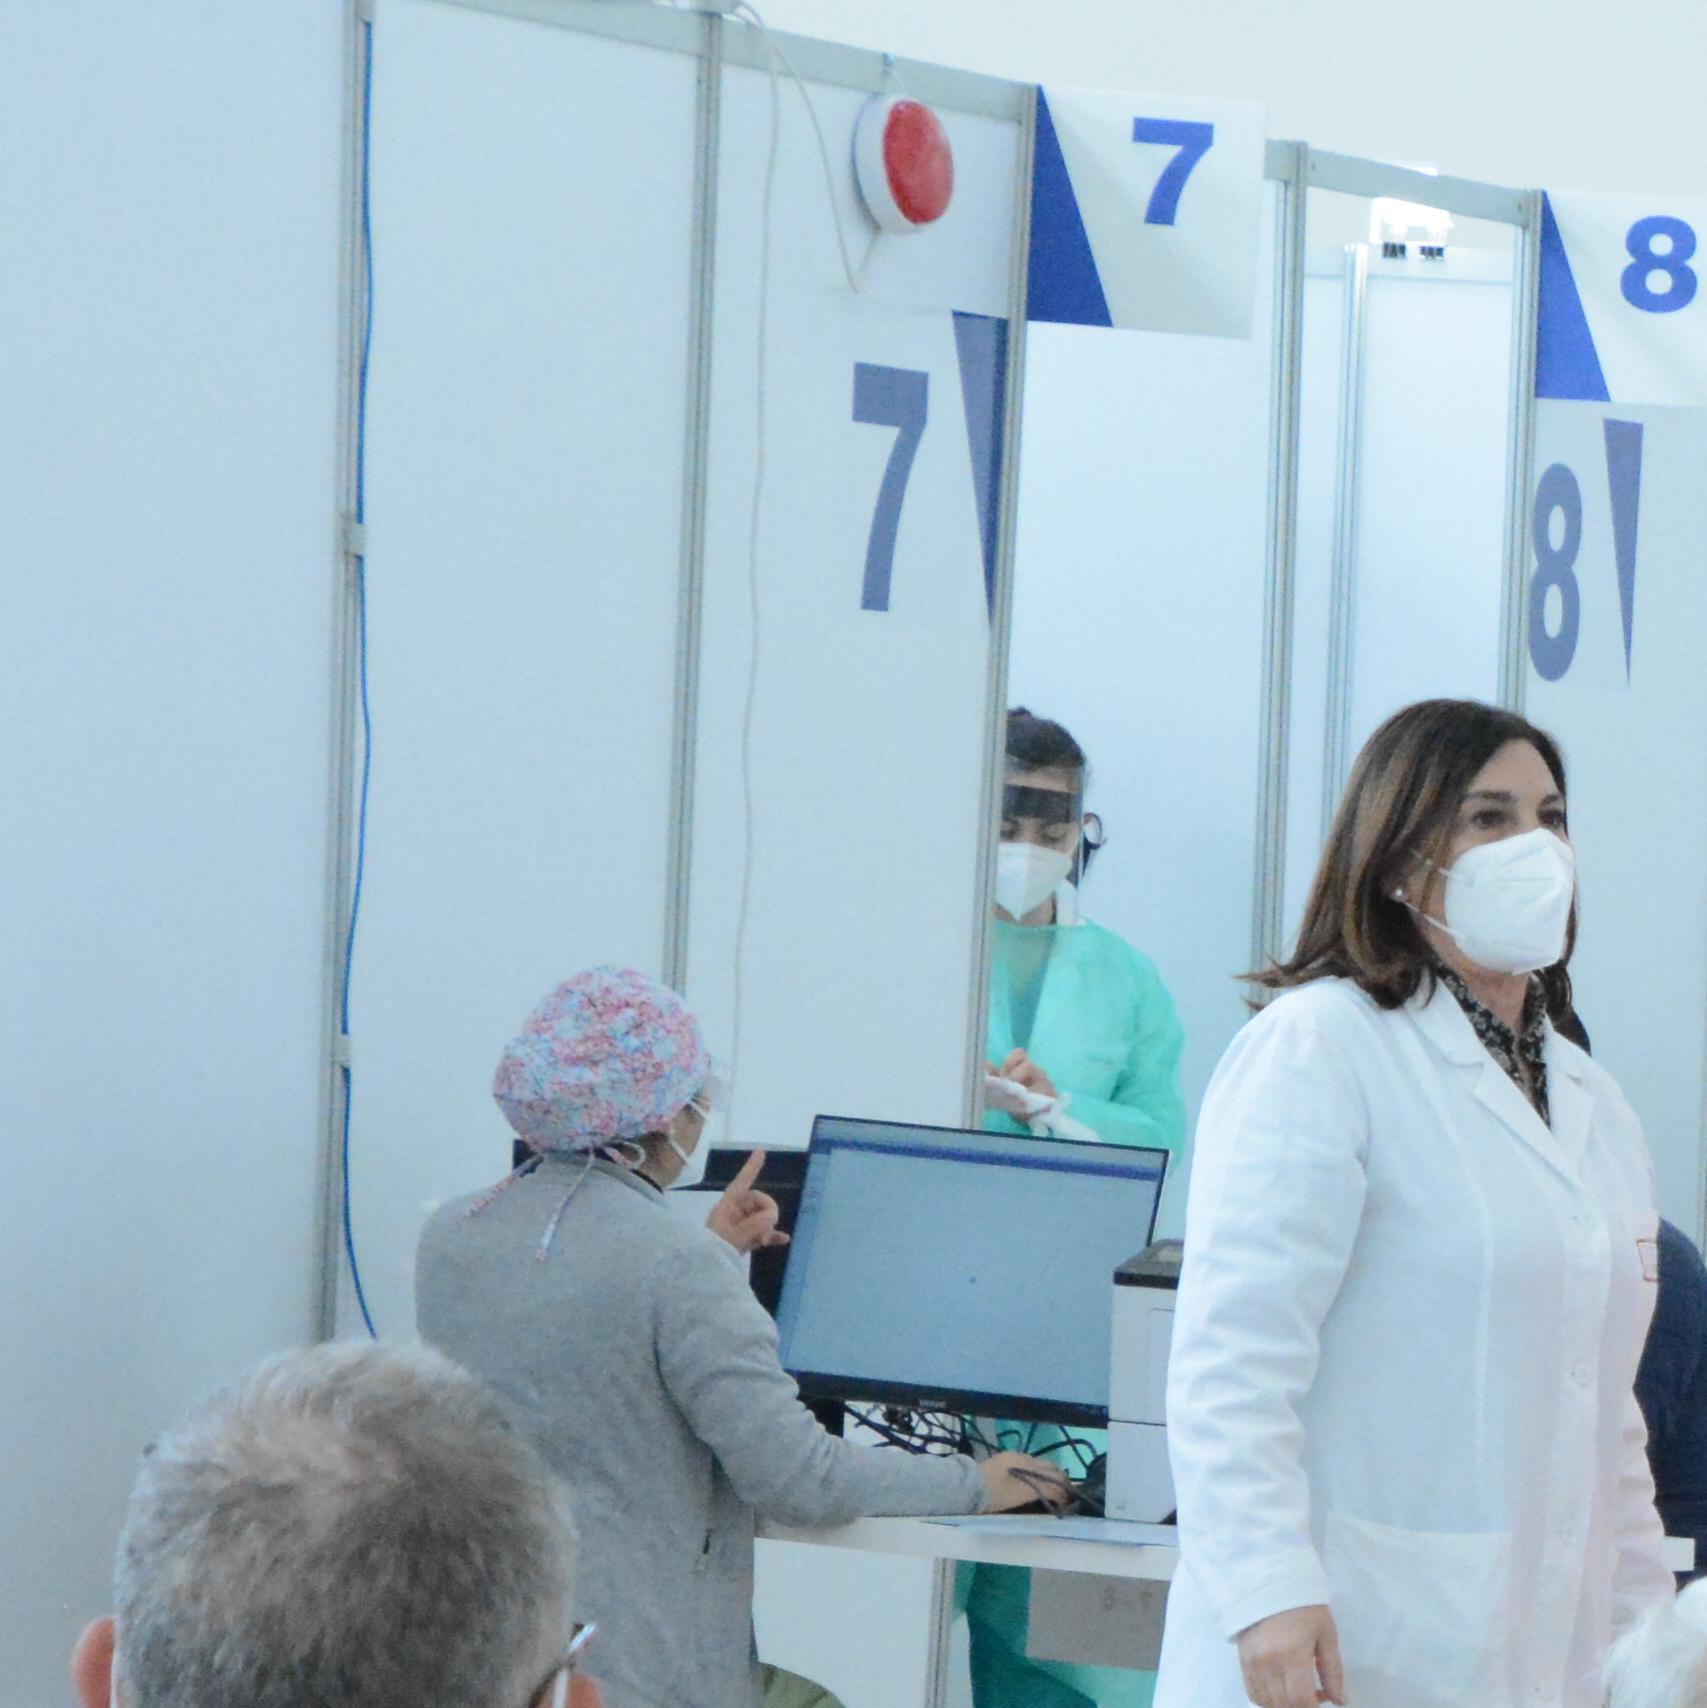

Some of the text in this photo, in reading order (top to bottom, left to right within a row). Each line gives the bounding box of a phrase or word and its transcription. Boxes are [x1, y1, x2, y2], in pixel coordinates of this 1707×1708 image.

[1132, 117, 1214, 226] 7
[1620, 216, 1698, 313] 8
[852, 362, 929, 613] 7
[1528, 463, 1583, 682] 8
